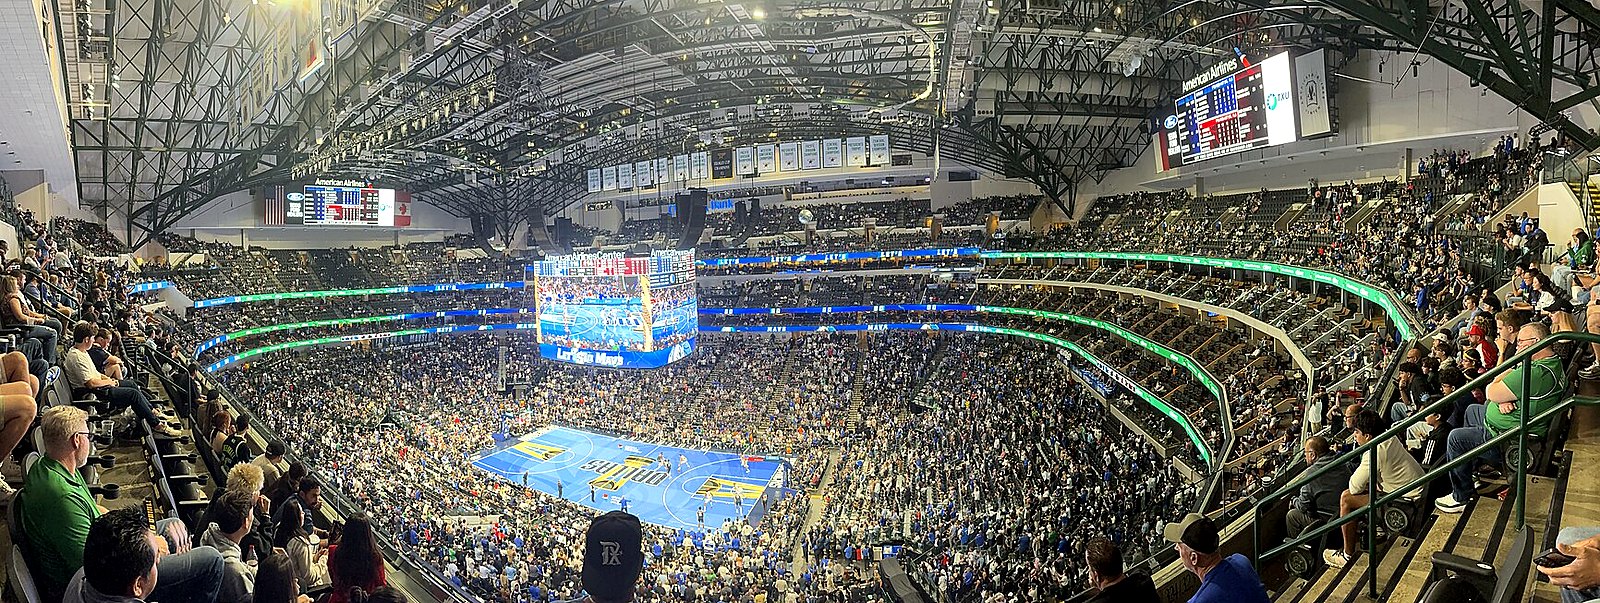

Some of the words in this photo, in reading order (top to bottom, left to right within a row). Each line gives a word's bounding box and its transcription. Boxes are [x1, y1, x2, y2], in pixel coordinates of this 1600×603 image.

[1182, 70, 1211, 94] American
[1210, 57, 1238, 80] Airlines
[315, 177, 343, 187] American
[578, 458, 670, 487] DALLAS
